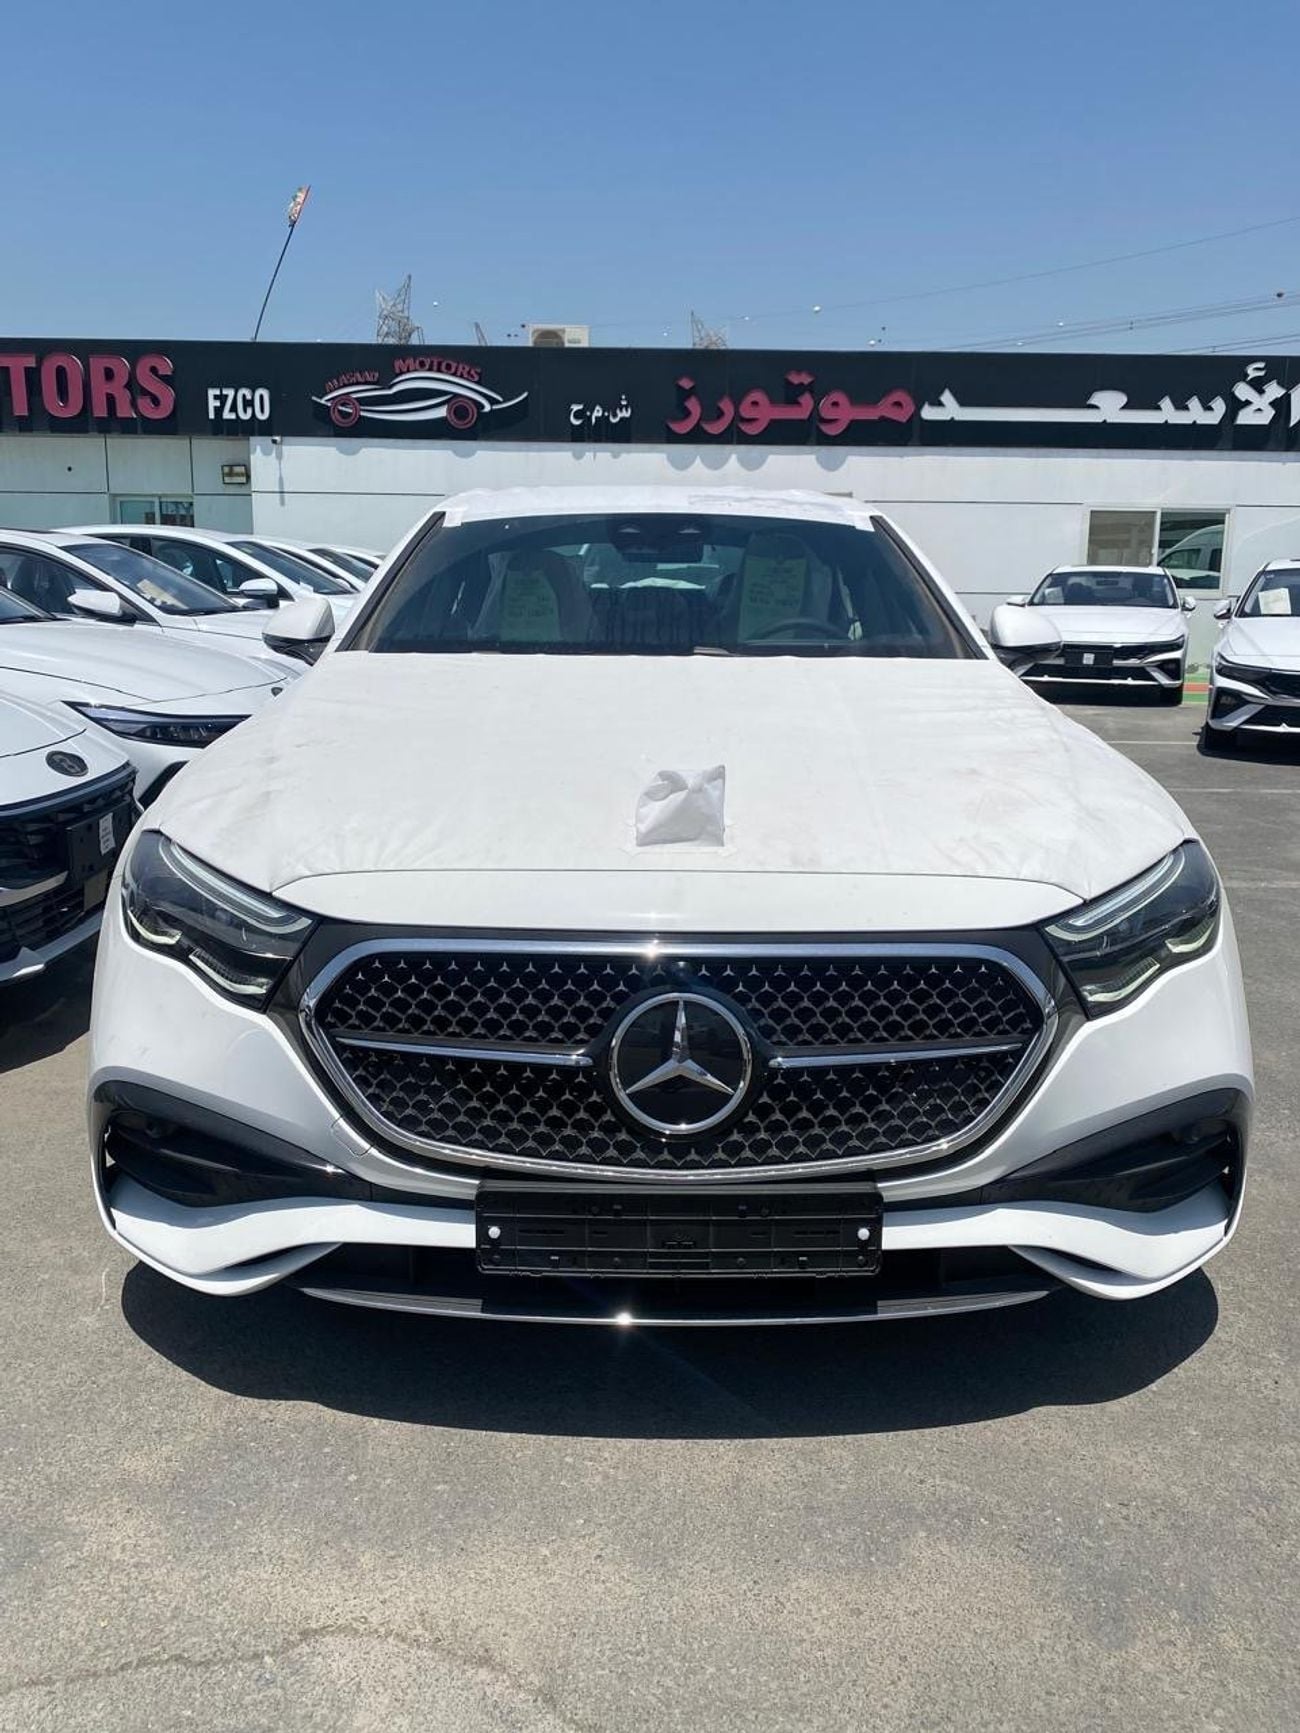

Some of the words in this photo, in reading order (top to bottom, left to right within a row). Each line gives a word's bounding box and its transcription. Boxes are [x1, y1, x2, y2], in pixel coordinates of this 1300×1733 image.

[0, 353, 176, 420] TORS
[207, 388, 270, 420] FZCO
[394, 357, 481, 382] MOTORS
[666, 370, 916, 436] موتورز
